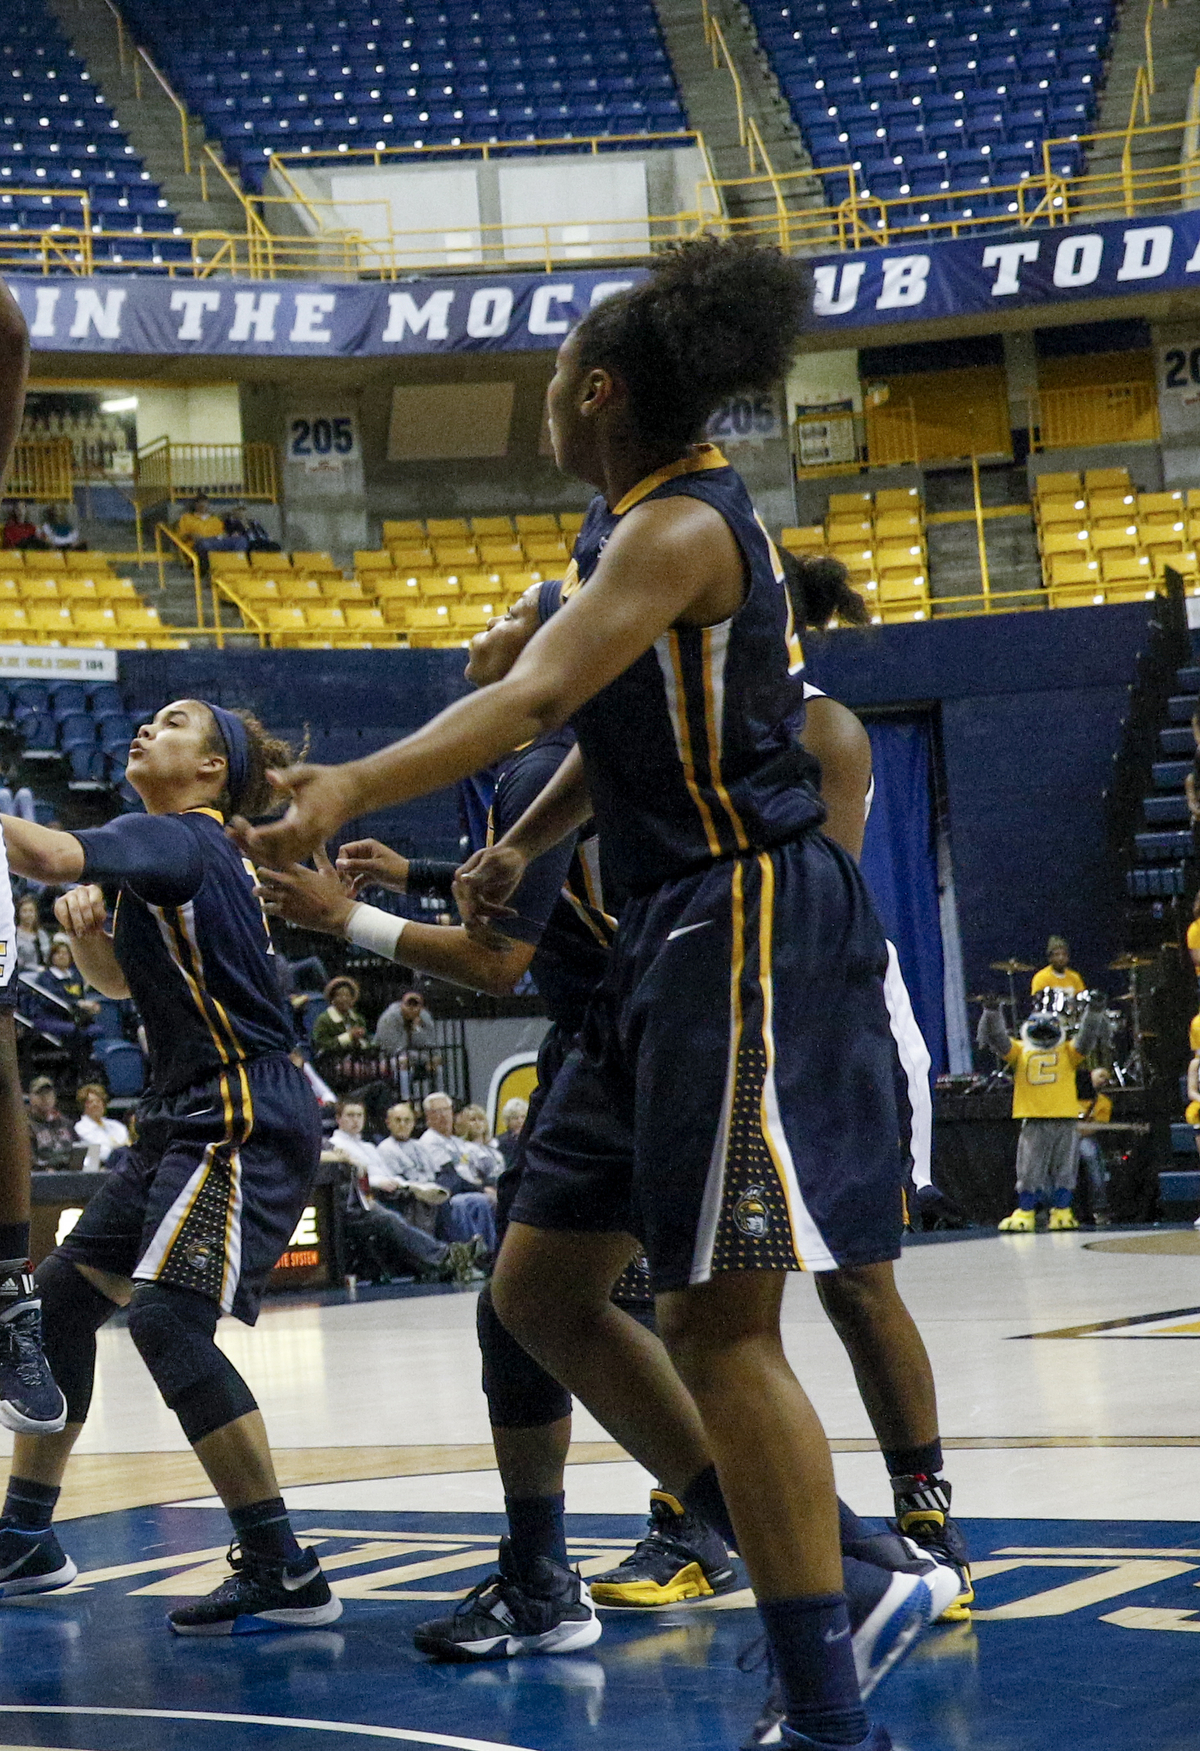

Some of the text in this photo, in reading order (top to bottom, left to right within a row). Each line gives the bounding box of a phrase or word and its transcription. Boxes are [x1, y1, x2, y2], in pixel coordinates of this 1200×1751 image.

[170, 290, 335, 342] THE
[382, 281, 633, 342] MOC
[813, 255, 931, 316] UB
[982, 225, 1200, 296] TOD
[292, 417, 353, 455] 205
[1026, 1052, 1057, 1085] C
